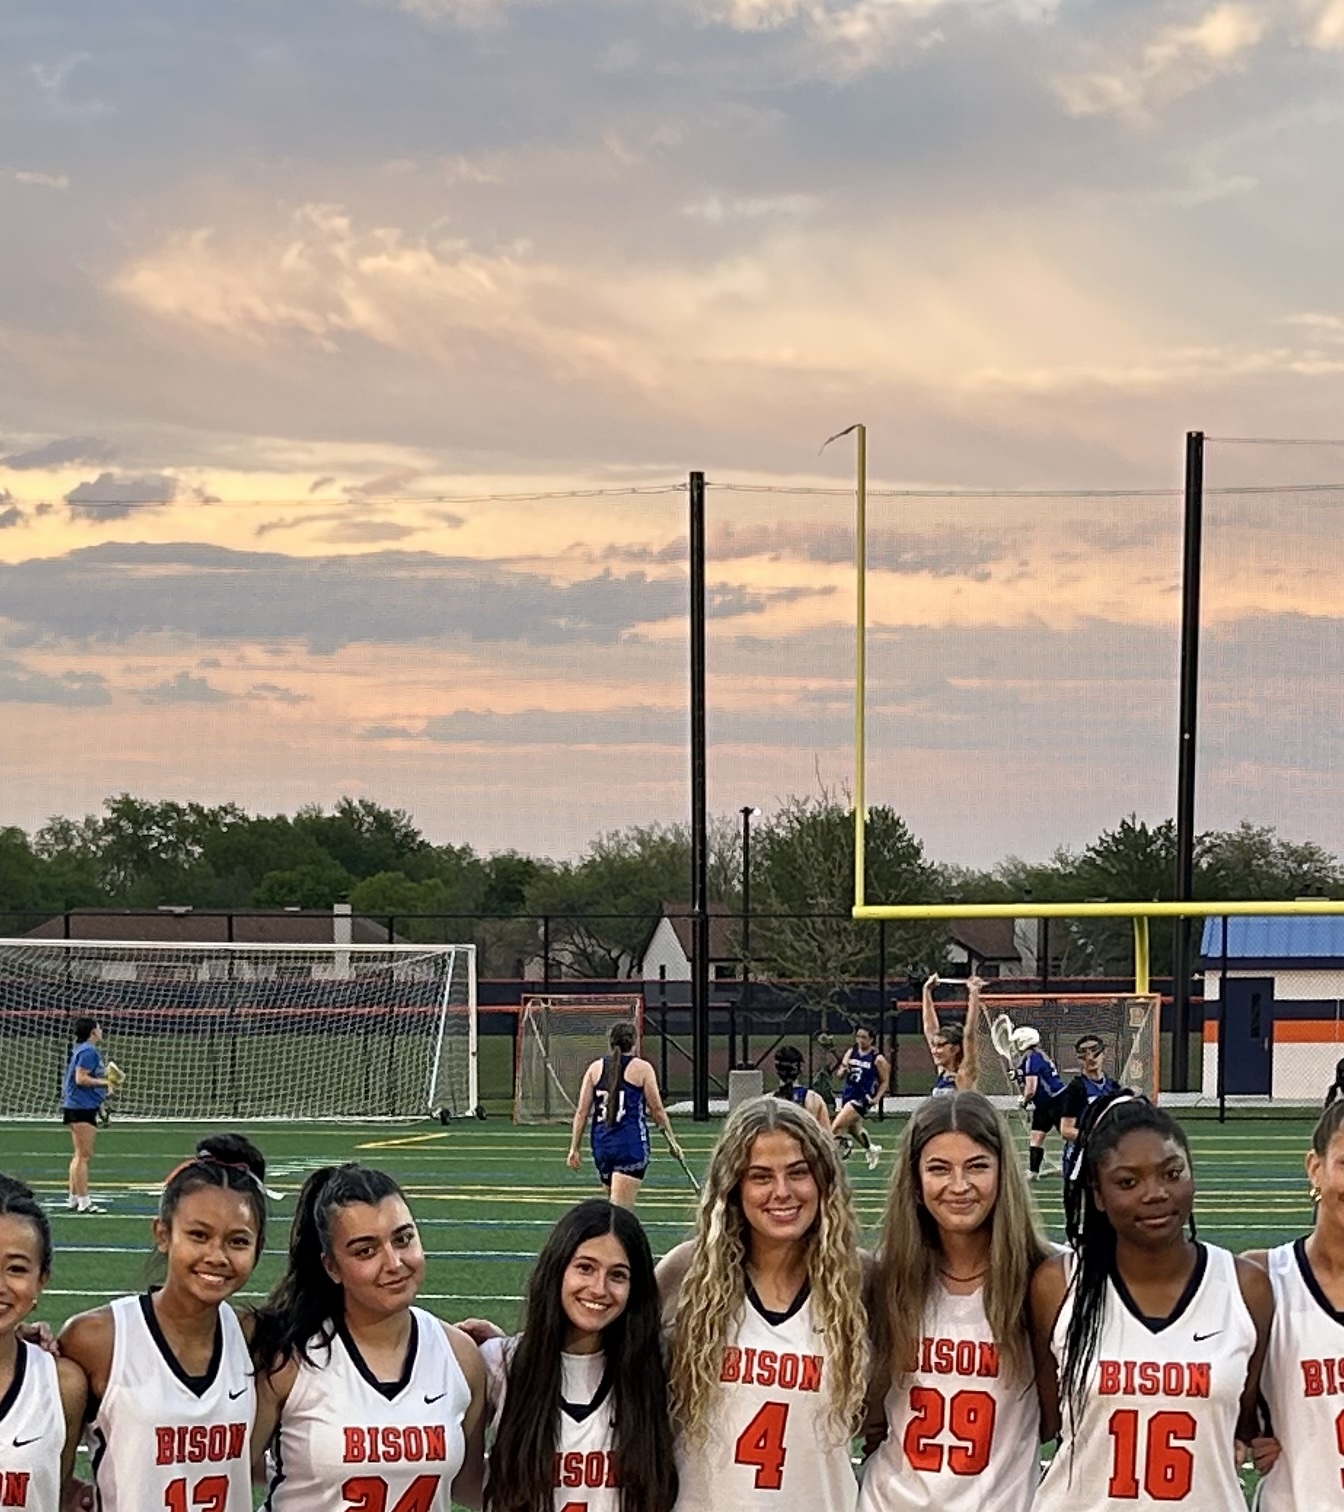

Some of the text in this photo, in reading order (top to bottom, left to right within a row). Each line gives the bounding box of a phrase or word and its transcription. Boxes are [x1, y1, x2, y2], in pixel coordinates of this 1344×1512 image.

[720, 1346, 824, 1393] BISON
[1099, 1360, 1211, 1398] BISON
[156, 1422, 247, 1465] BISON
[343, 1425, 446, 1463] BISON
[734, 1401, 789, 1490] 4
[903, 1386, 996, 1476] 29
[1108, 1409, 1197, 1501] 16
